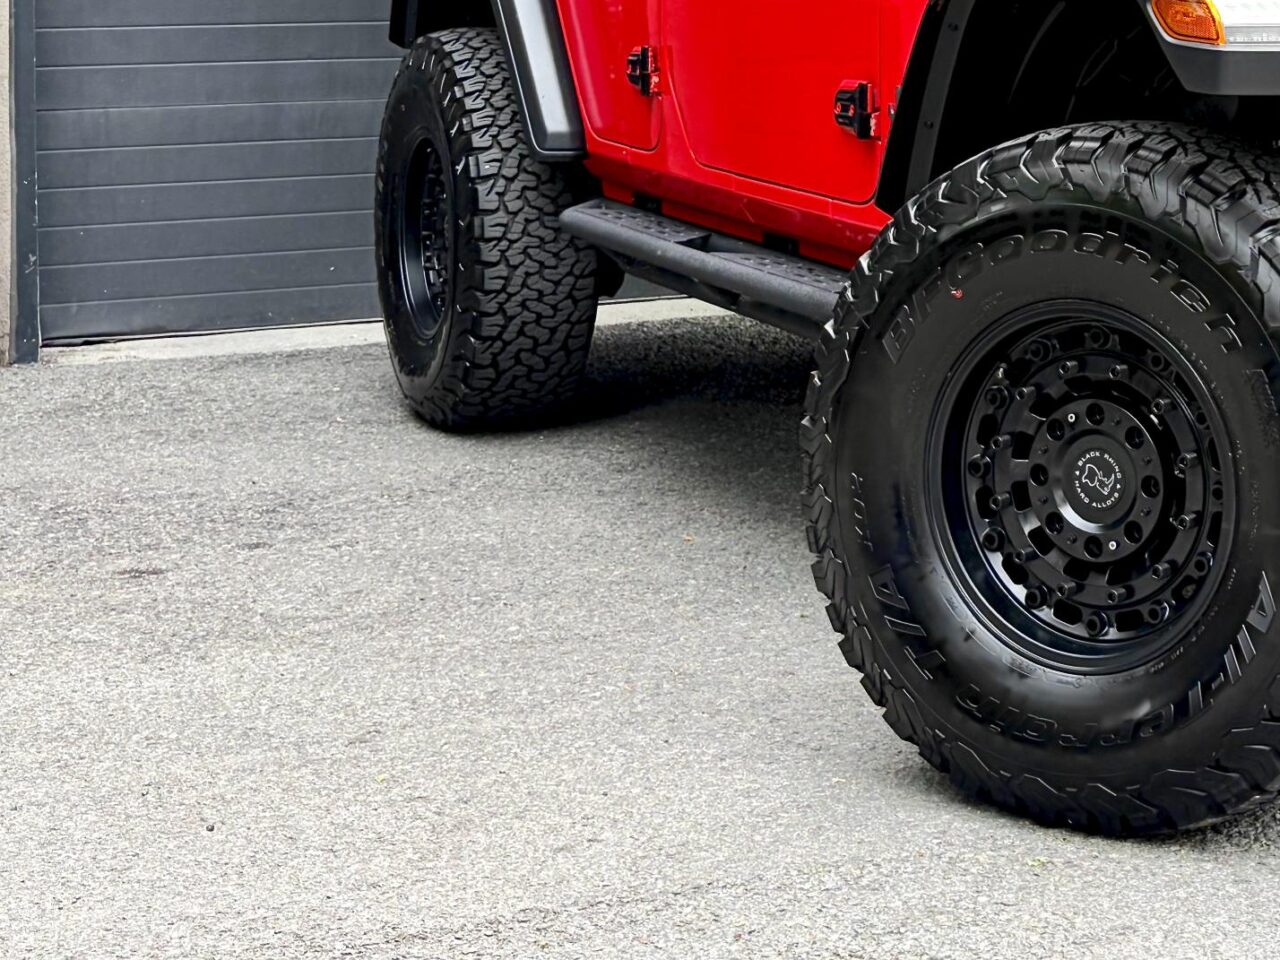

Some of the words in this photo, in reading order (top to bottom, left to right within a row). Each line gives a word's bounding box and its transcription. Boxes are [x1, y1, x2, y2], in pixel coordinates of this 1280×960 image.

[882, 228, 1243, 364] BFGoodrich
[1077, 451, 1101, 467] BLACK
[1103, 453, 1122, 479] RHINO
[1074, 480, 1090, 504] HARD
[1092, 492, 1119, 508] ALLOYS
